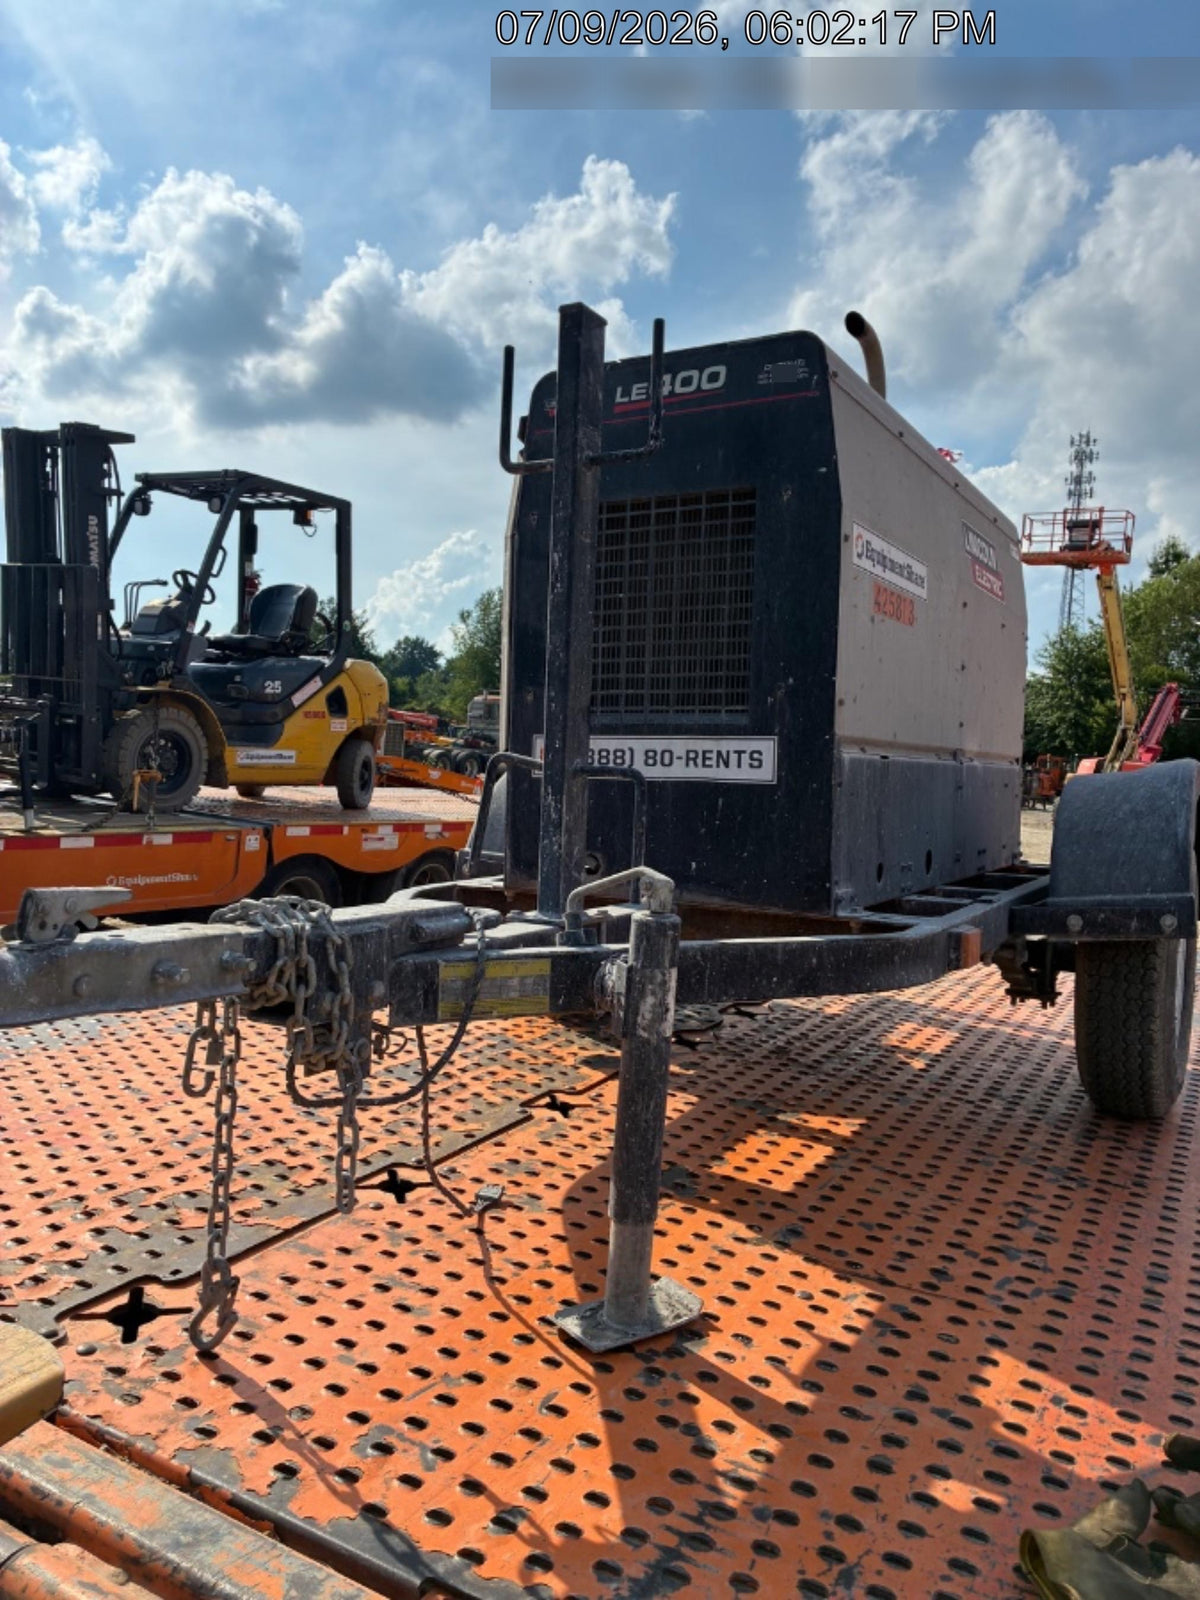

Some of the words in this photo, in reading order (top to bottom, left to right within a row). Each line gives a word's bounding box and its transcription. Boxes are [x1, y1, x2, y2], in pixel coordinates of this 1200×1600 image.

[87, 515, 100, 574] MATSU
[264, 680, 282, 694] 25
[587, 746, 635, 768] 888)
[643, 749, 764, 769] 80-RENTS
